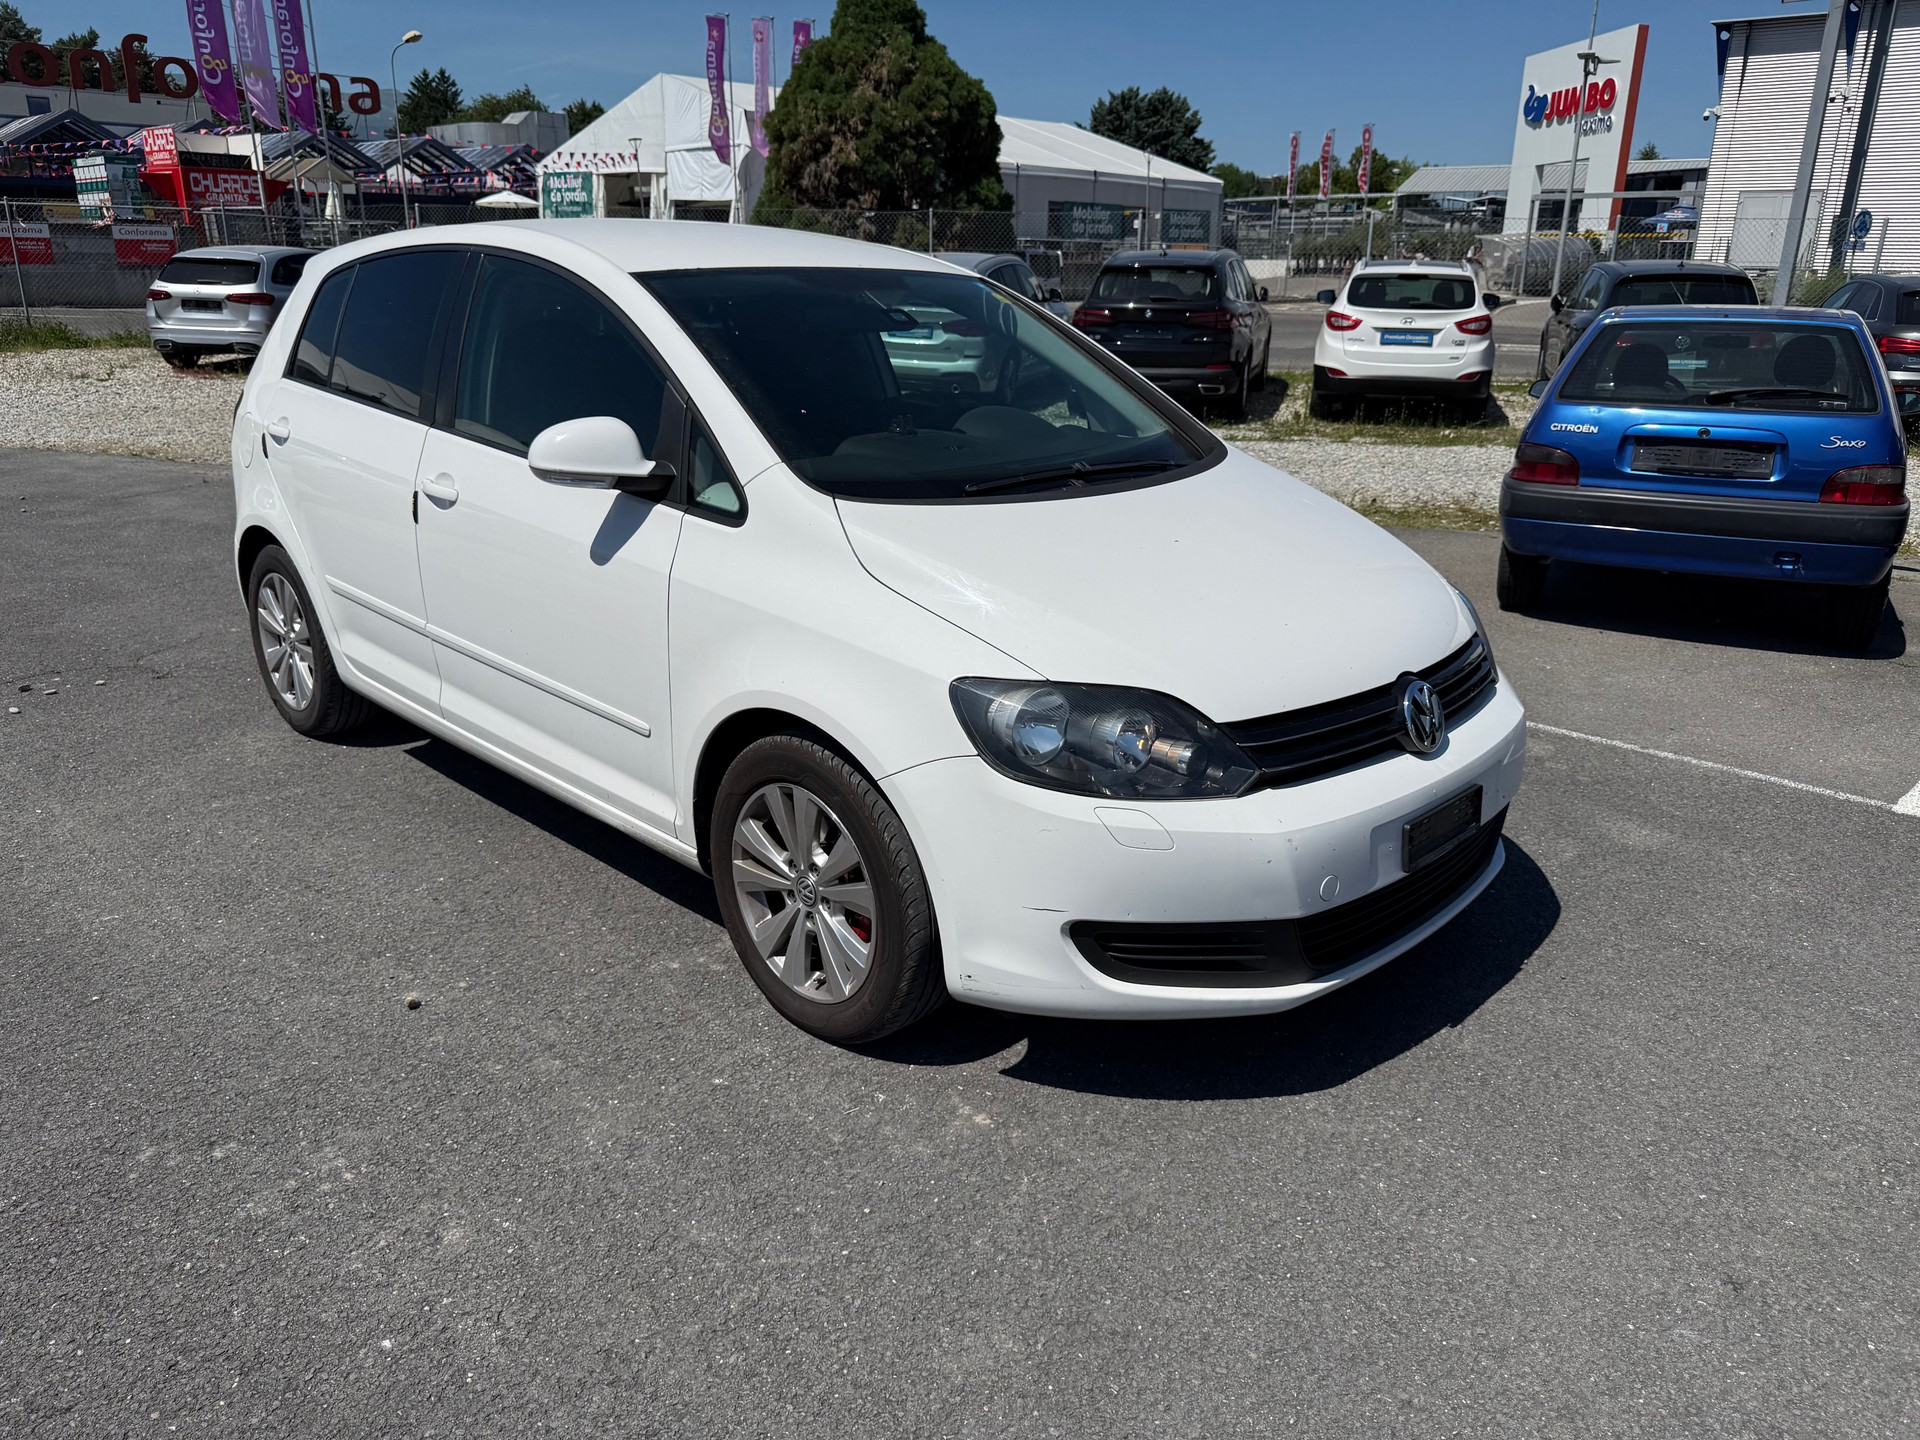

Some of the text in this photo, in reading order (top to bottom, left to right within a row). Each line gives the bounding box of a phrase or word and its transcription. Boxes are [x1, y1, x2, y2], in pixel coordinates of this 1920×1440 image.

[1544, 78, 1616, 122] JUMBO
[1574, 115, 1612, 133] aximo
[189, 172, 261, 195] CHURROS
[205, 192, 250, 202] GRANITAS
[562, 188, 588, 205] jardin
[118, 227, 168, 237] Conforama
[1550, 422, 1599, 434] CITROËN
[1820, 435, 1867, 449] Saxo
